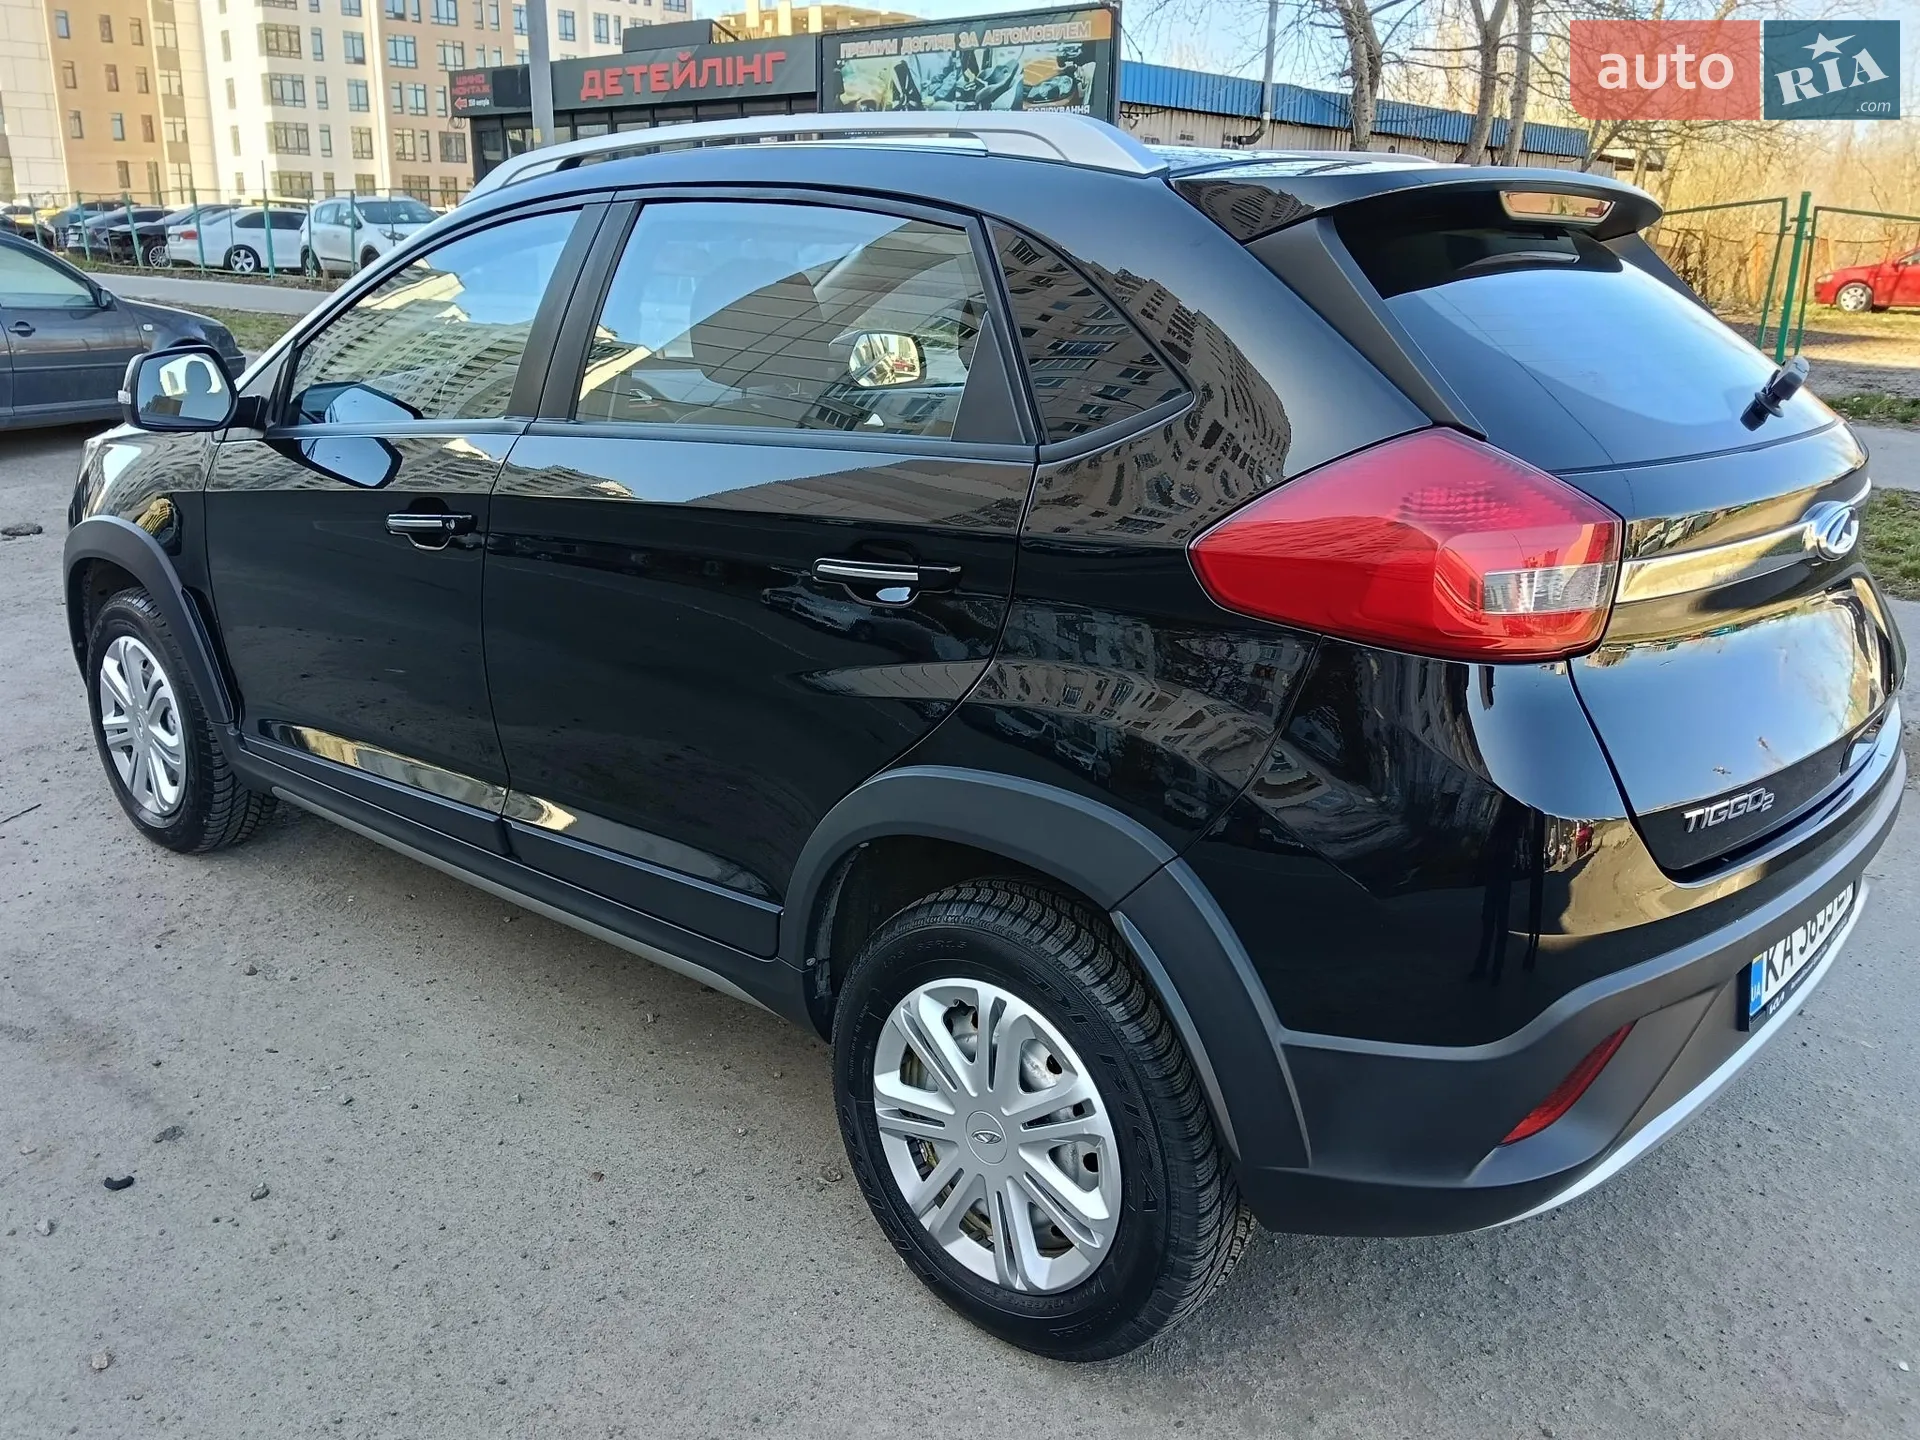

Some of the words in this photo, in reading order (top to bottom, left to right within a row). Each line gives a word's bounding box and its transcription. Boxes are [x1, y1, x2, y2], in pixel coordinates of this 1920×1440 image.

[958, 31, 979, 49] ЗА
[981, 21, 1092, 46] АВТОМОБІЛЕМ
[580, 51, 787, 101] ДЕТЕЙЛІНГ
[1750, 983, 1762, 1003] UA
